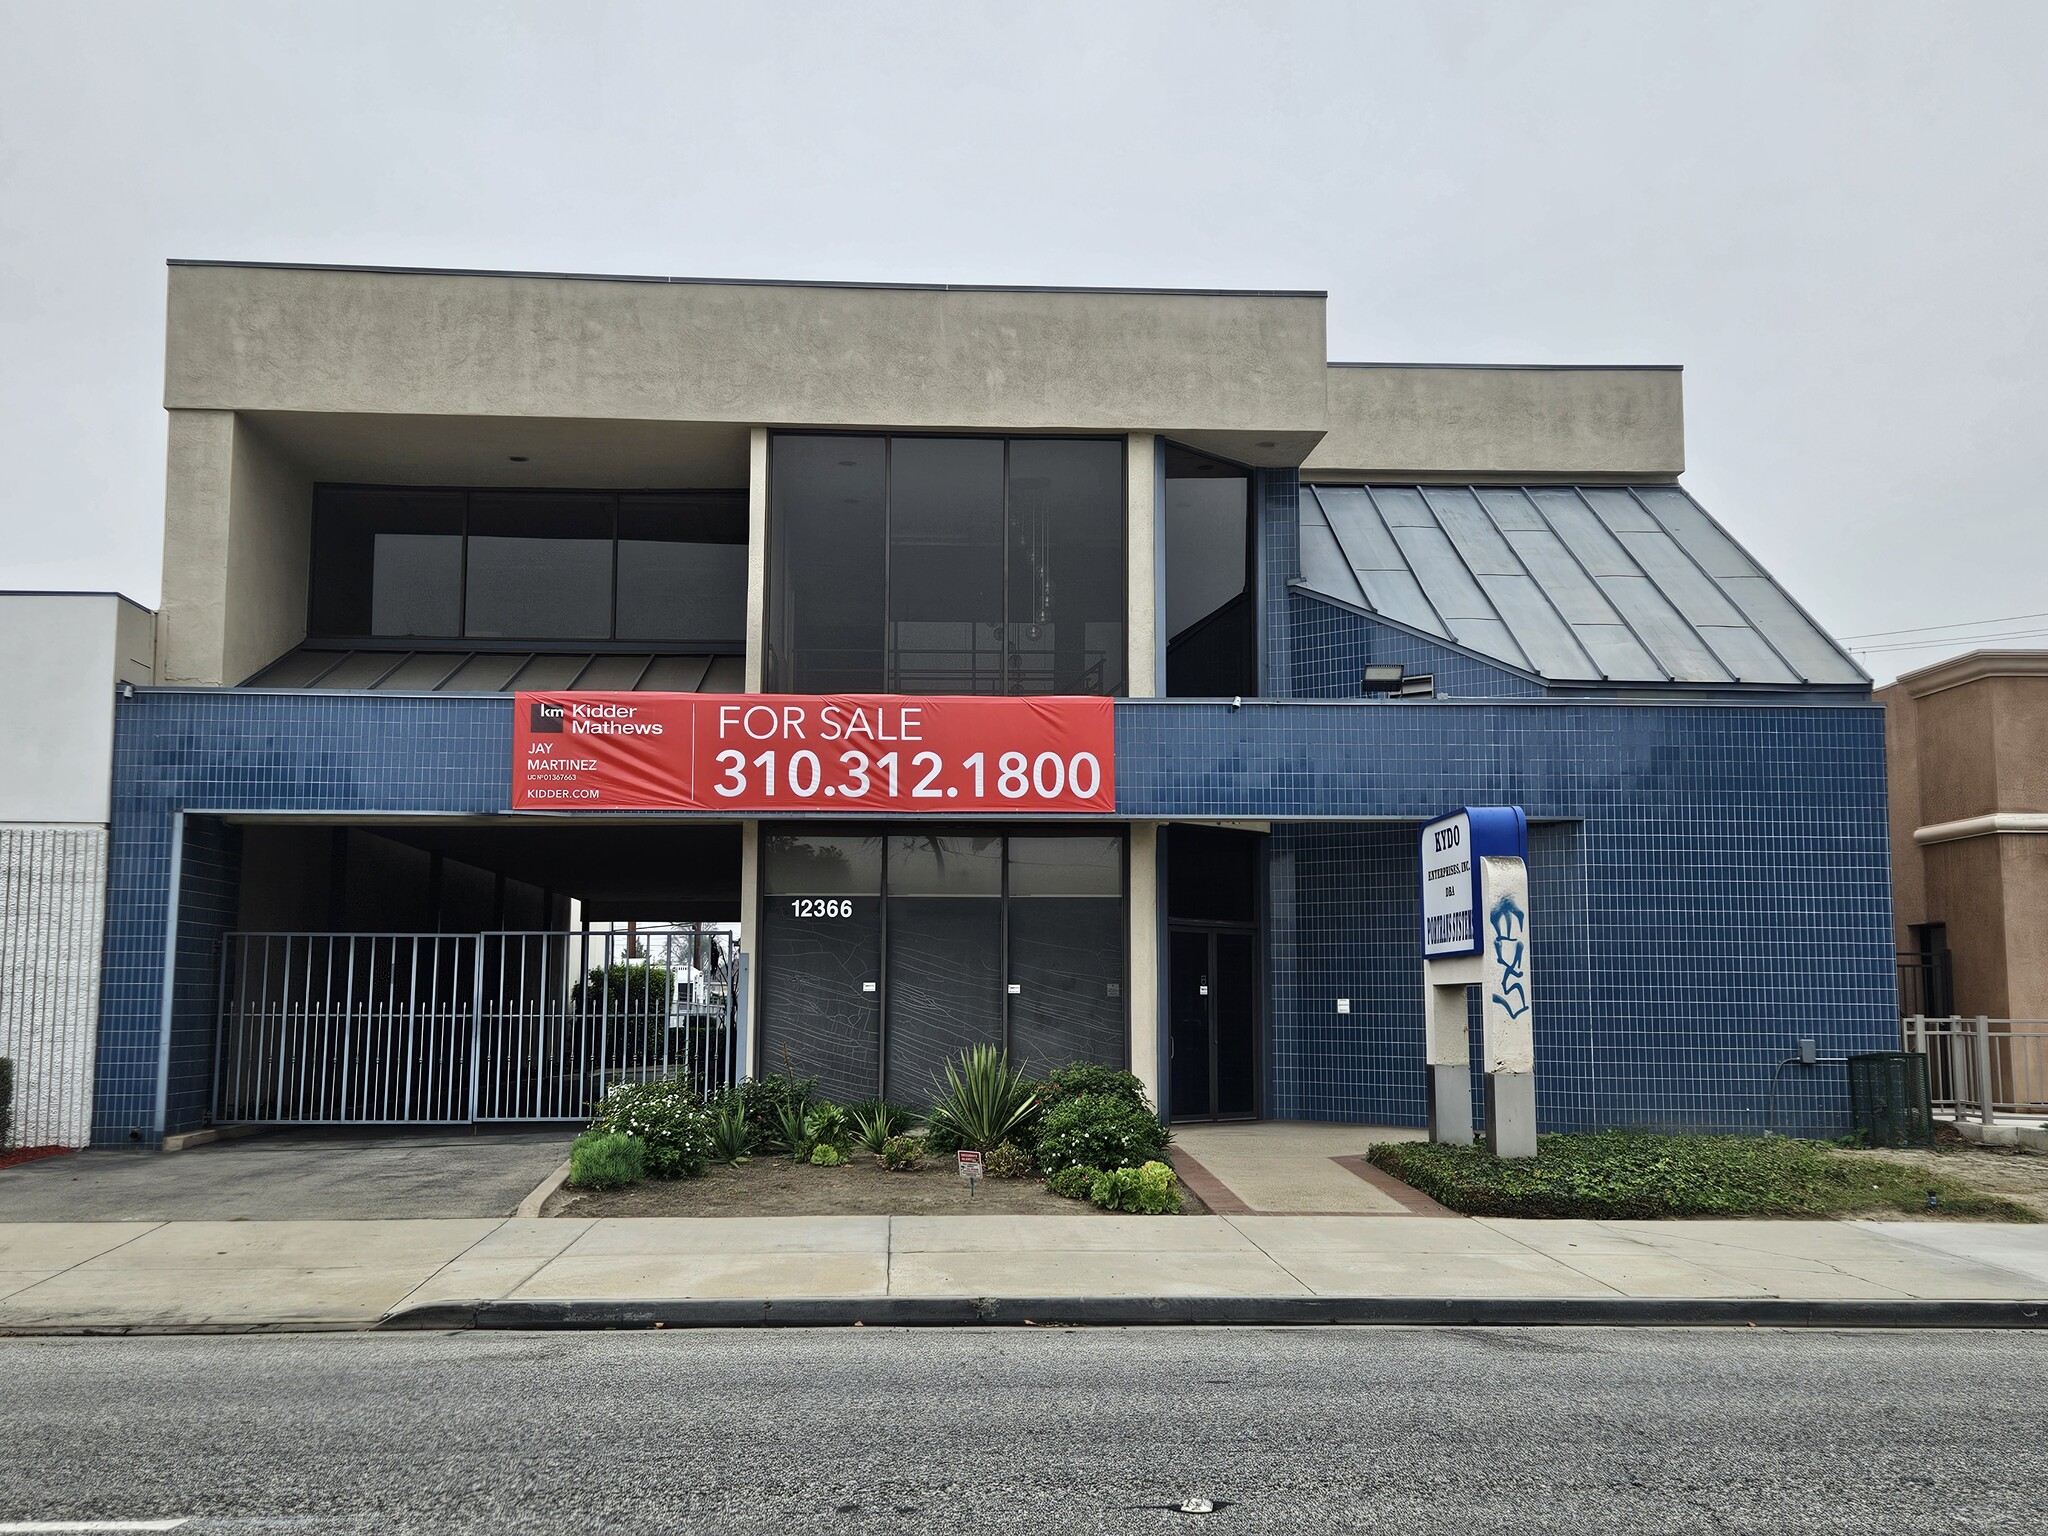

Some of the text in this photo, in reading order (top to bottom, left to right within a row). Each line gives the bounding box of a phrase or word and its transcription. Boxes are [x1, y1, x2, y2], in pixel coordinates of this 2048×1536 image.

[540, 703, 564, 718] km
[572, 704, 637, 719] Kidder
[572, 720, 663, 735] Mathews
[720, 705, 922, 741] FOR SALE
[528, 742, 554, 754] JAY
[527, 759, 598, 771] MARTINEZ
[713, 749, 1101, 799] 310.312.1800
[527, 789, 600, 799] KIDDER.COM
[1434, 825, 1460, 852] KYDO
[791, 899, 853, 918] 12366
